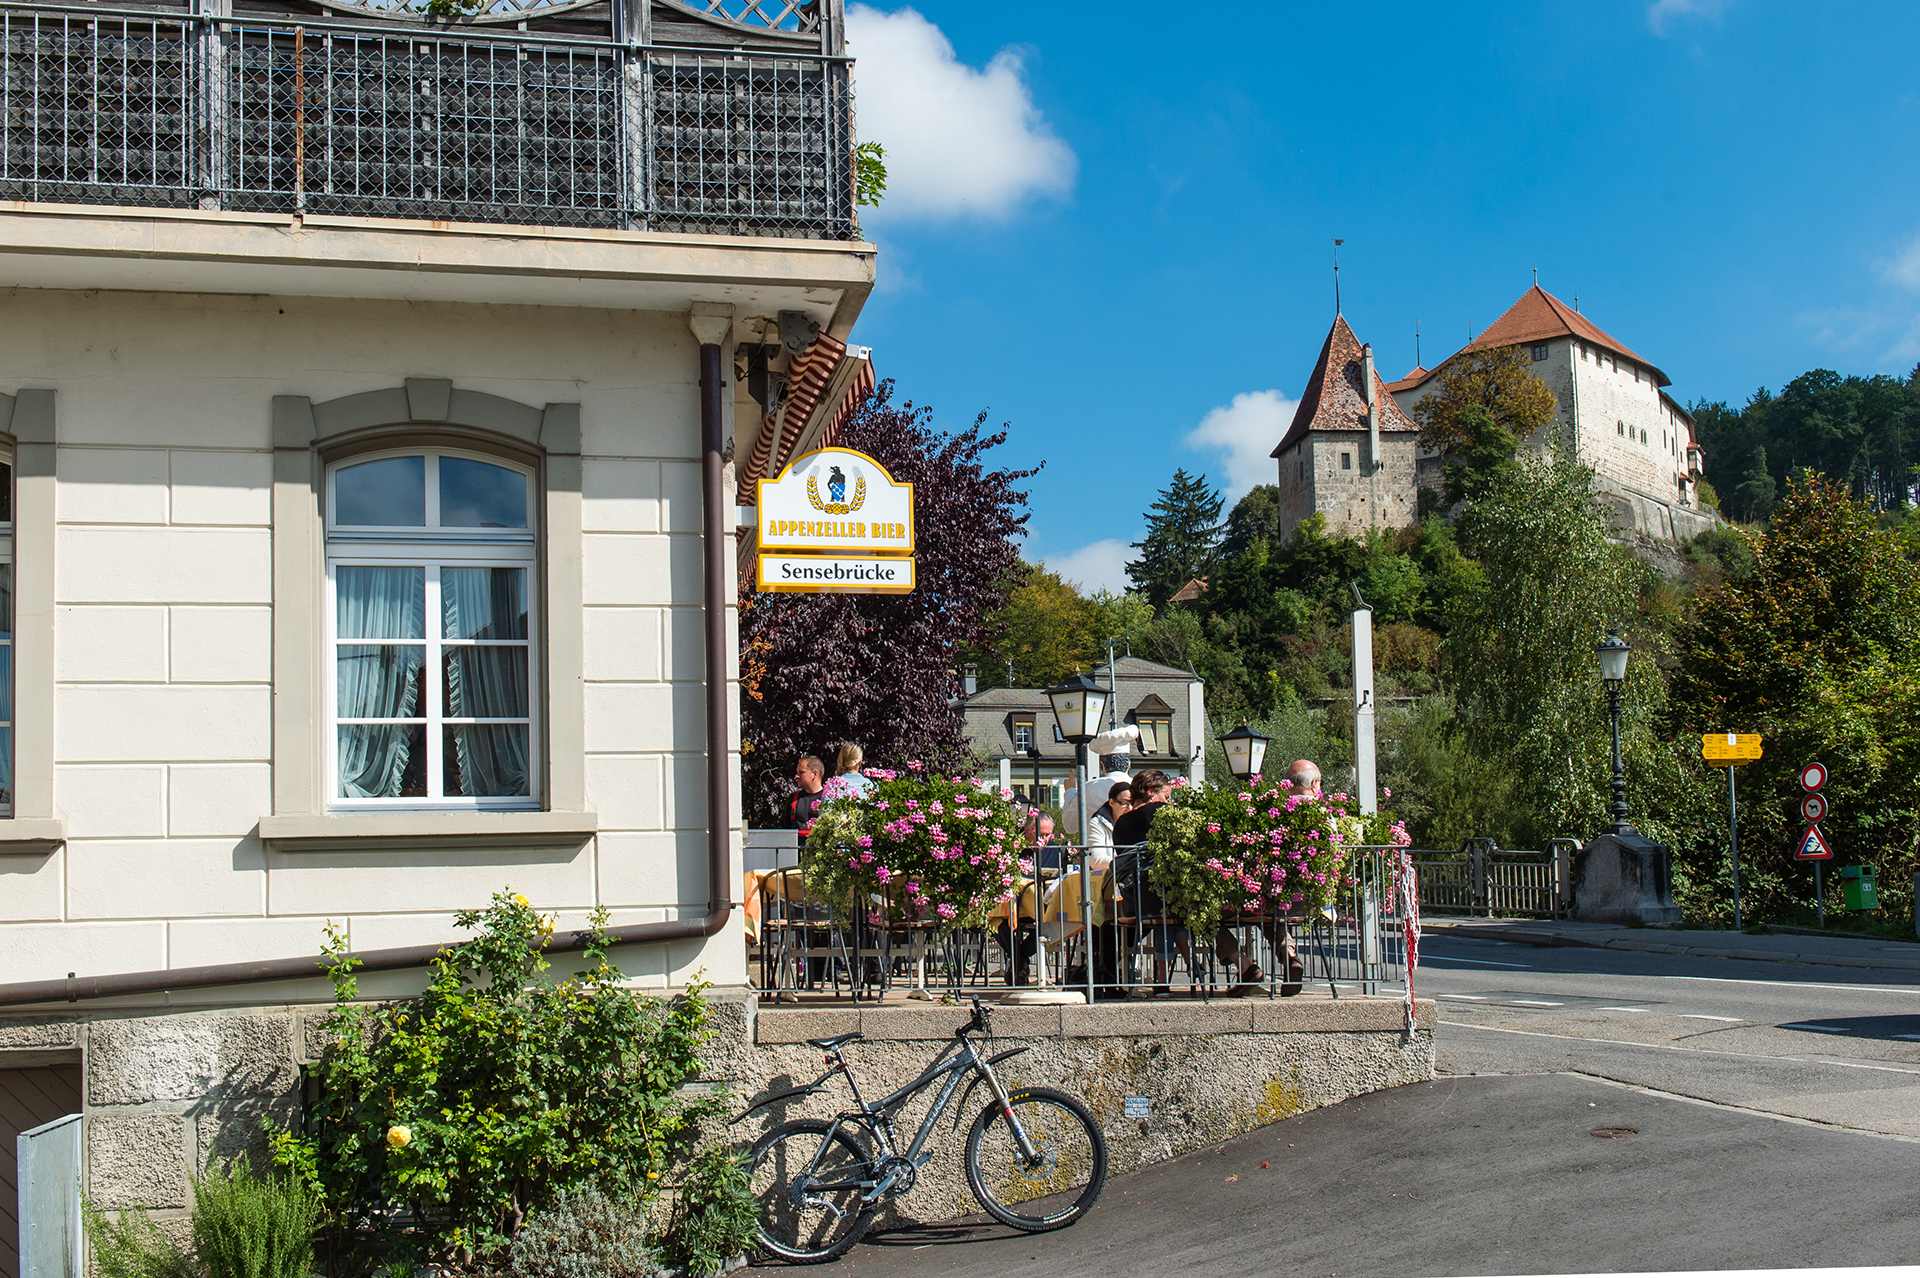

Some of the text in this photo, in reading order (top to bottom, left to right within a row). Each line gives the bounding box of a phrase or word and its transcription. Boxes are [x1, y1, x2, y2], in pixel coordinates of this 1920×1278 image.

[768, 520, 906, 539] APPENZELLER BIER
[781, 562, 896, 580] Sensebrücke
[923, 1073, 958, 1127] TREK
